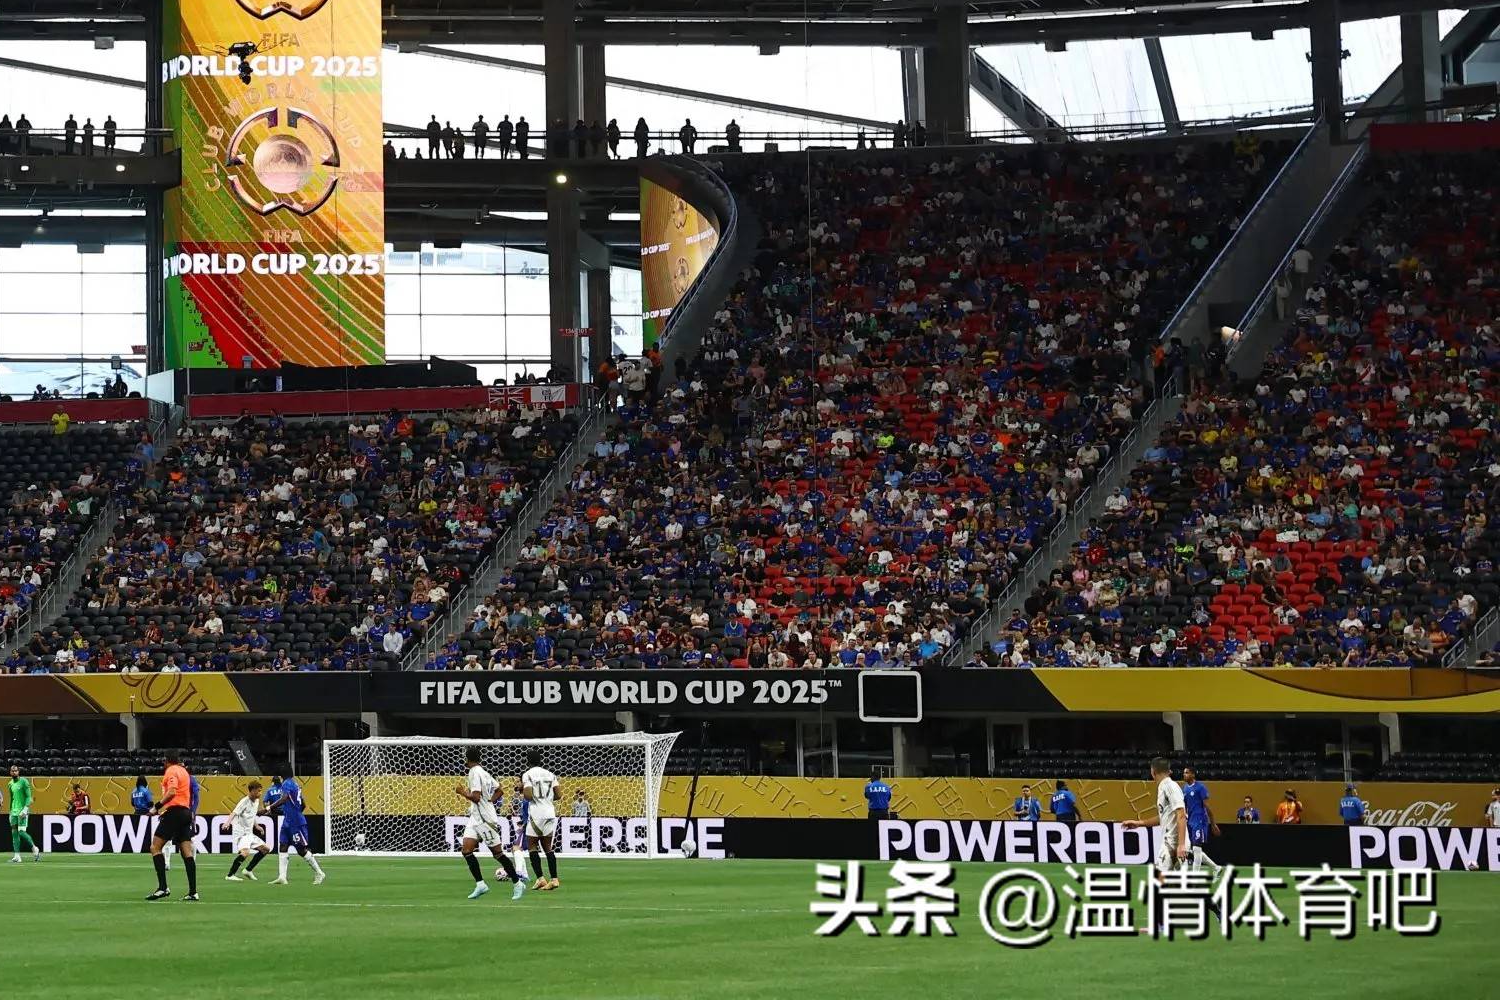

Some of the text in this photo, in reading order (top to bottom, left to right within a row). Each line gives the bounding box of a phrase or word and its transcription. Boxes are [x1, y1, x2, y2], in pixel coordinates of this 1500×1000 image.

[169, 55, 242, 80] WORLD
[251, 55, 305, 77] CUP
[311, 56, 380, 77] 2025
[169, 253, 245, 278] WORLD
[252, 254, 306, 275] CUP
[420, 681, 481, 704] FIFA
[487, 680, 562, 704] CLUB
[569, 681, 678, 704] WORLD
[685, 680, 745, 704] CUP
[534, 780, 553, 799] 17
[879, 819, 1161, 864] POWERAD
[1195, 829, 1201, 839] 6
